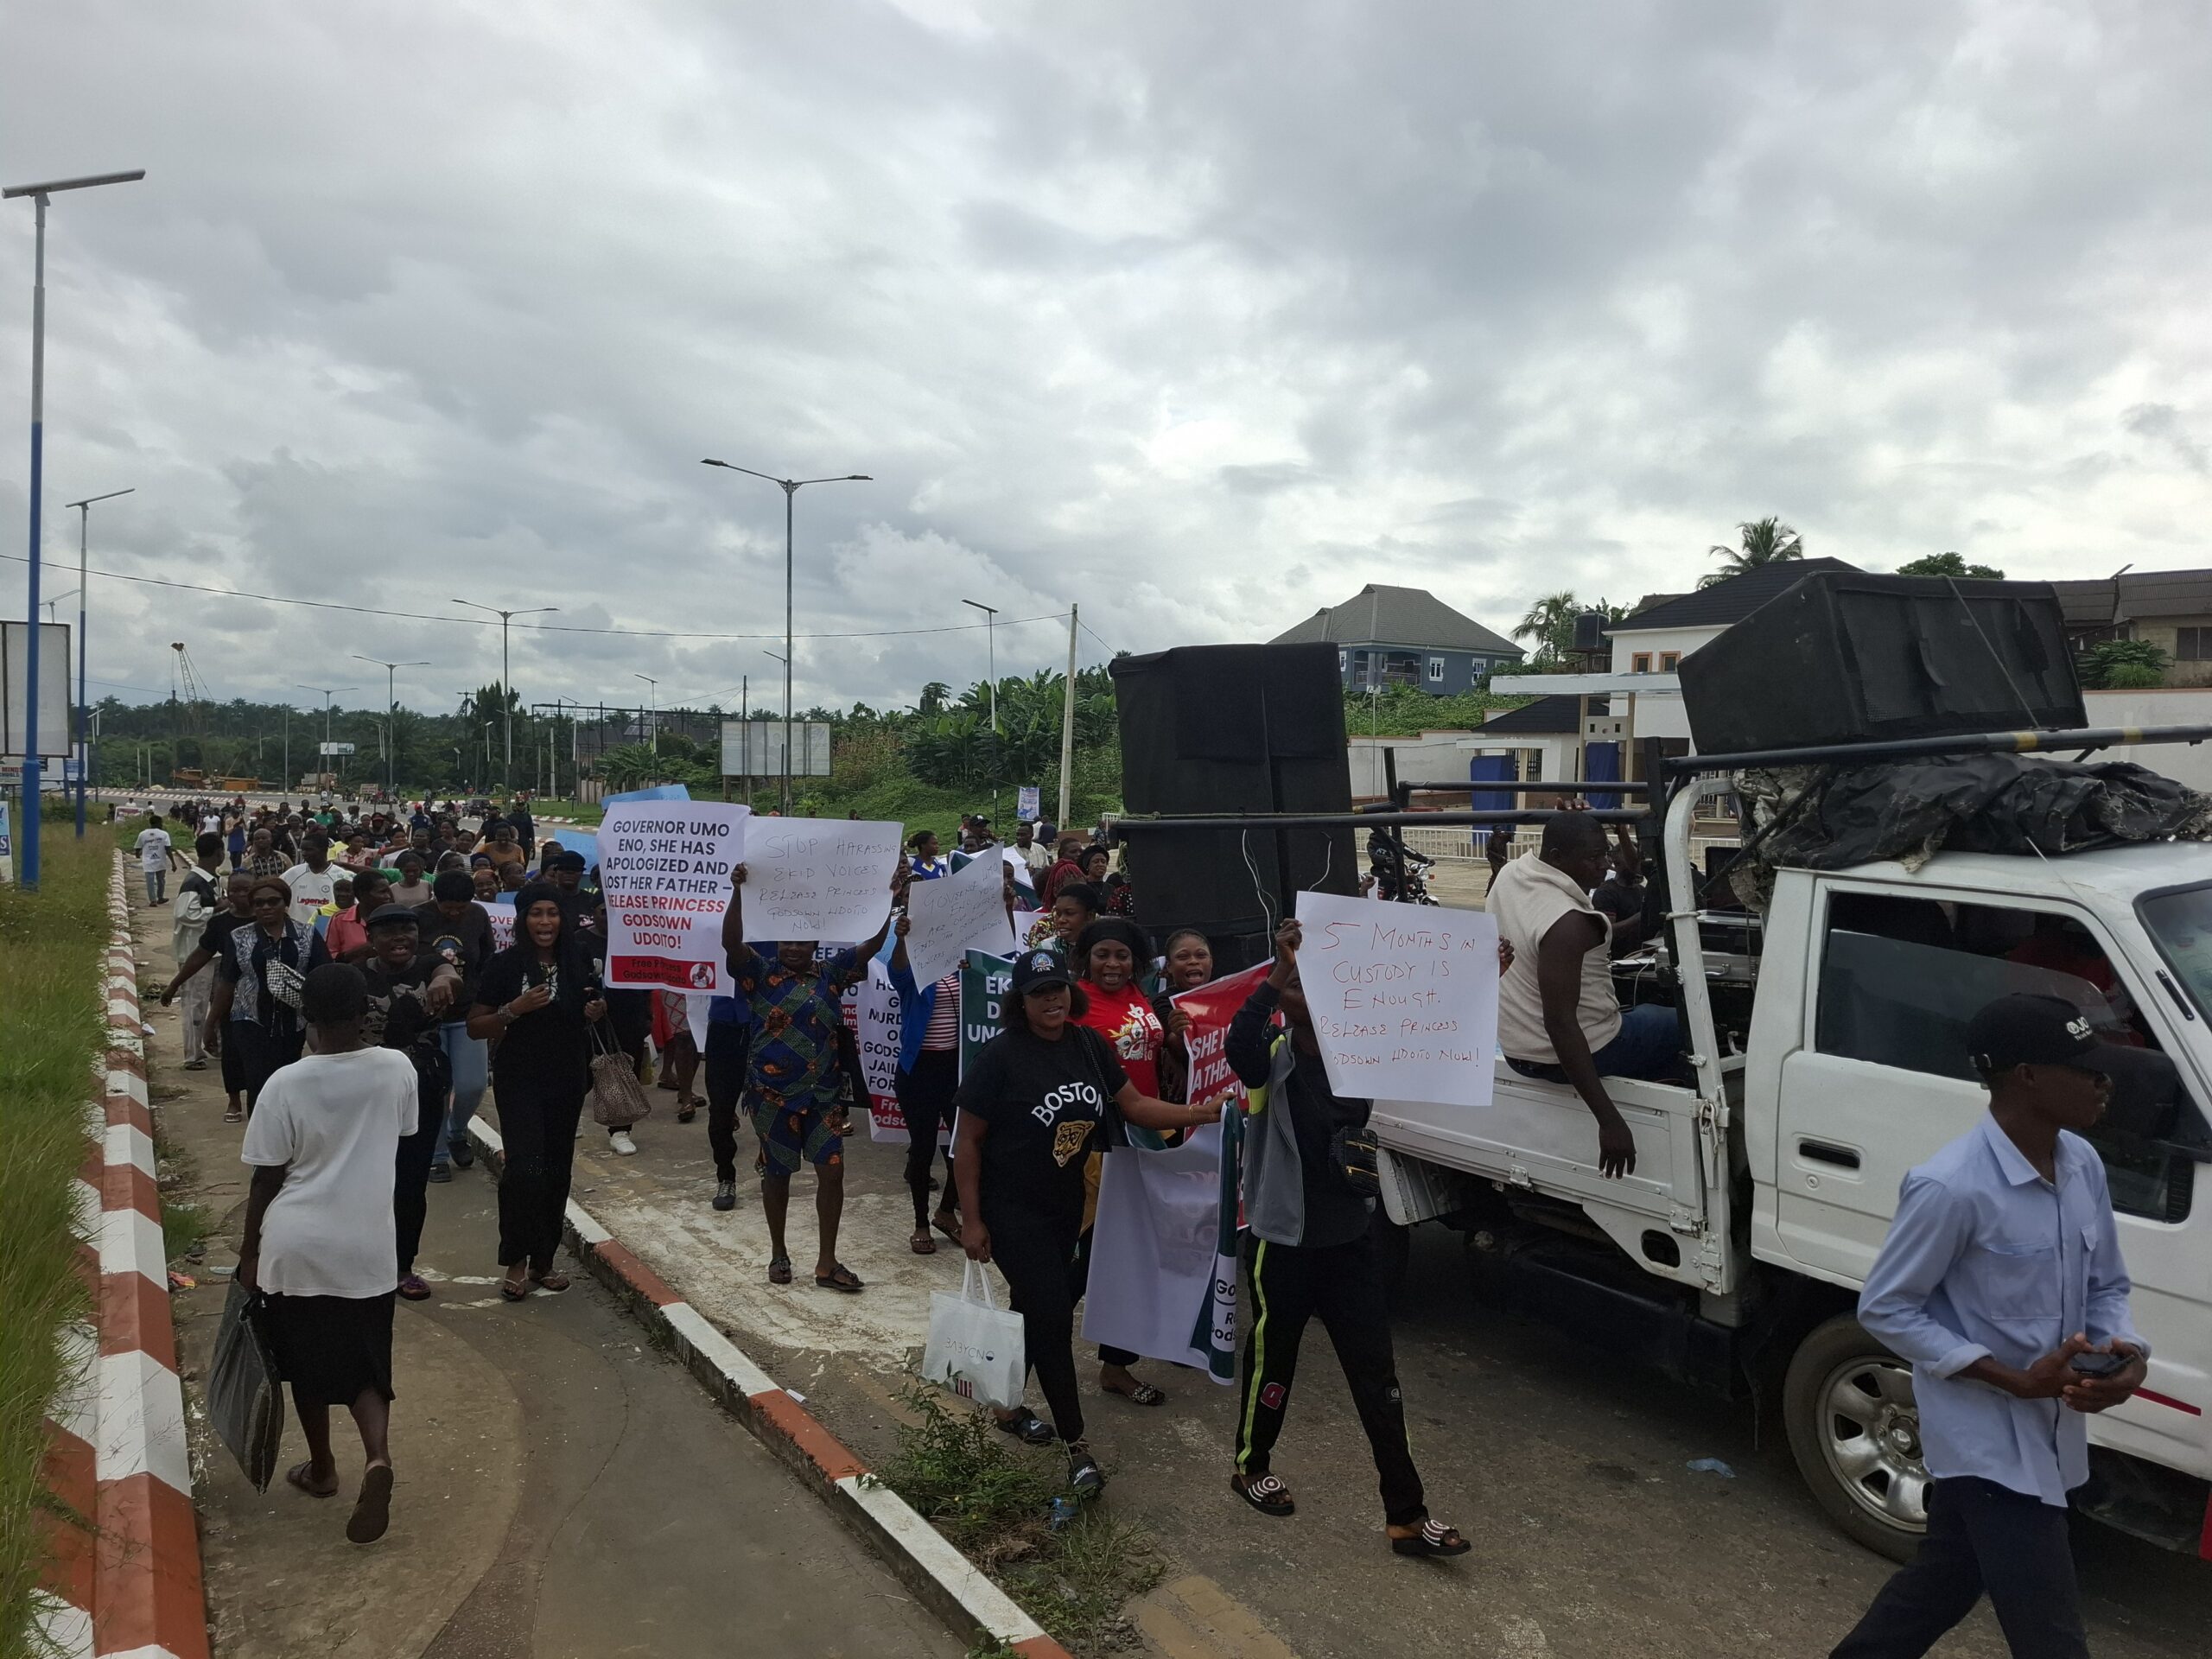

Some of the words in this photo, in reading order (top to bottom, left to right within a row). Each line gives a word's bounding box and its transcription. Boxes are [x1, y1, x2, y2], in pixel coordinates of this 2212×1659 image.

[613, 820, 686, 835] GOVERNOR
[690, 822, 730, 837] UMO
[618, 838, 646, 854] ENO,
[650, 839, 677, 853] SHE
[681, 841, 715, 855] HAS
[766, 834, 818, 859] STOP
[836, 836, 897, 857] HARASSING
[607, 857, 690, 874] APOLOGIZED
[693, 861, 729, 875] AND
[774, 867, 816, 882] EKID
[825, 864, 879, 878] VOICES
[630, 876, 652, 890] HER
[656, 877, 718, 894] FATHER
[652, 895, 726, 913] PRINCESS
[759, 887, 817, 906] RELEASE
[825, 886, 877, 899] PRINCESS
[622, 913, 692, 931] GODSOWN
[632, 932, 682, 950] UDOITO!
[1320, 922, 1361, 950] 5
[1371, 923, 1452, 950] MONTHS
[1460, 938, 1476, 950] IN
[1332, 960, 1416, 984] CUSTODY
[1431, 960, 1451, 976] IS
[1319, 1015, 1388, 1038] RELEASE
[1400, 1018, 1459, 1038] PRINCESS
[864, 1041, 901, 1058] GODS
[1192, 1029, 1219, 1061] SHE
[1333, 1052, 1381, 1065] ODSOWN
[1391, 1048, 1431, 1063] UDOITO
[1439, 1047, 1480, 1068] NOW!
[880, 1098, 902, 1112] Fre
